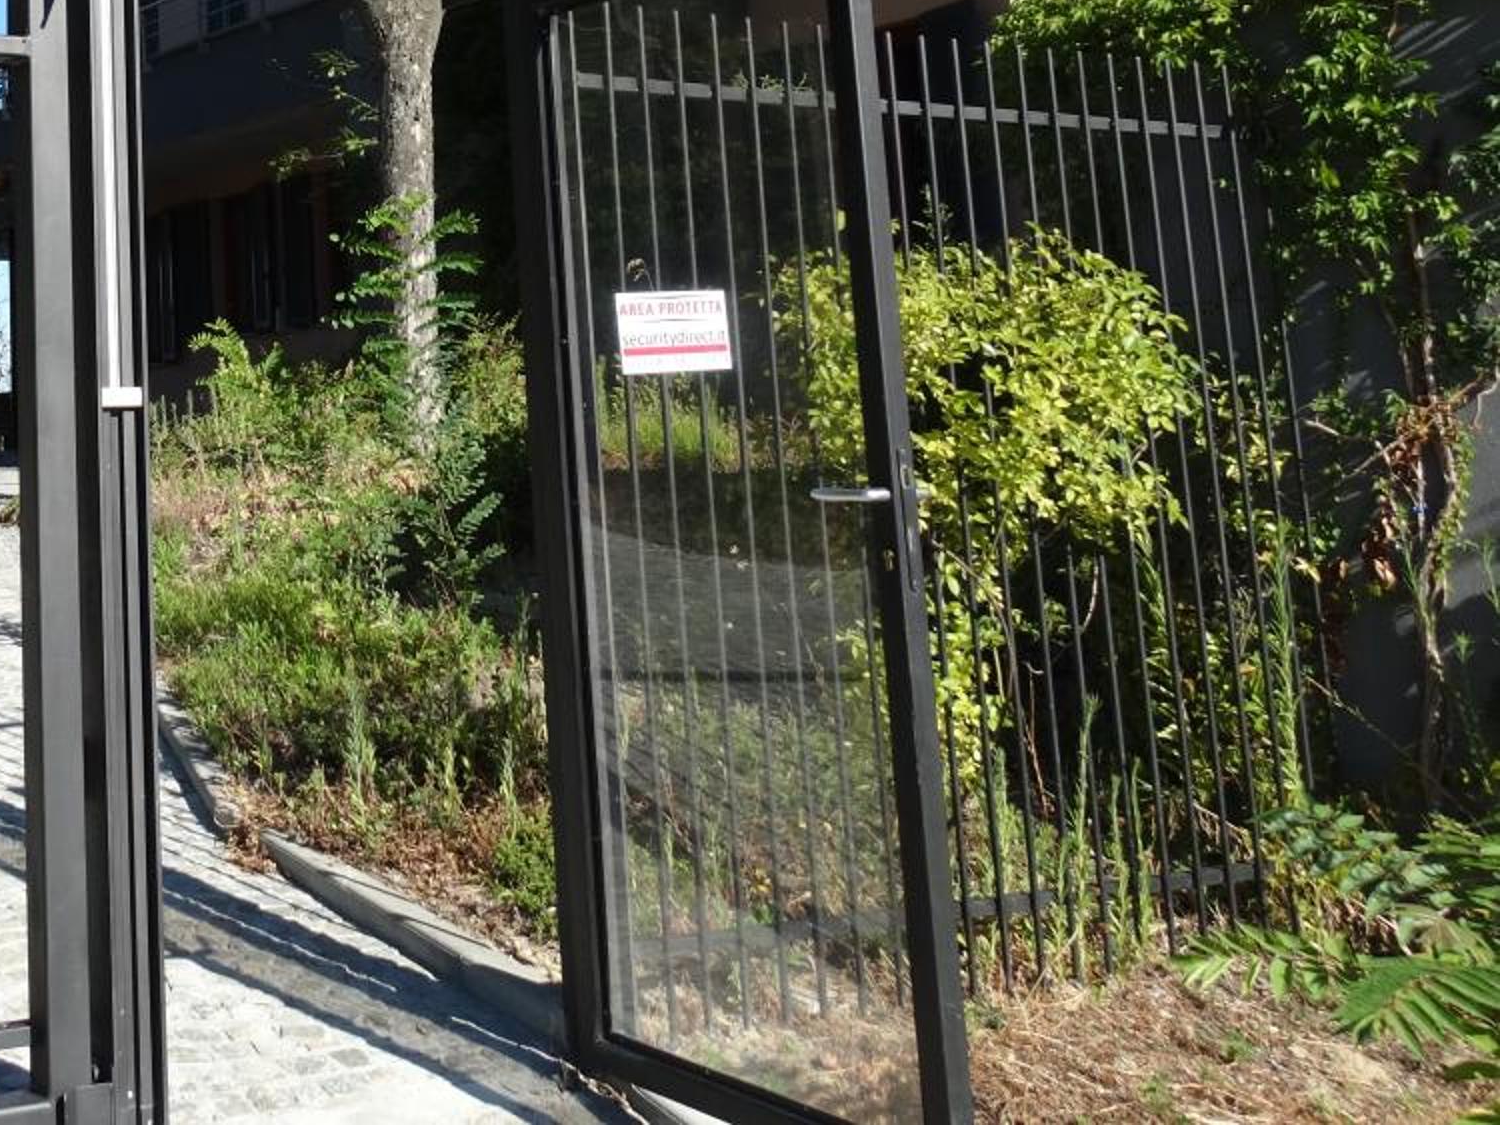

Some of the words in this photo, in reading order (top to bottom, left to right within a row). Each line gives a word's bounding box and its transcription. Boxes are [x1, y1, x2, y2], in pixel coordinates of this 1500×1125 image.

[620, 302, 655, 316] AREA
[658, 299, 723, 316] PROTETTA
[622, 330, 726, 348] securitydirect.it
